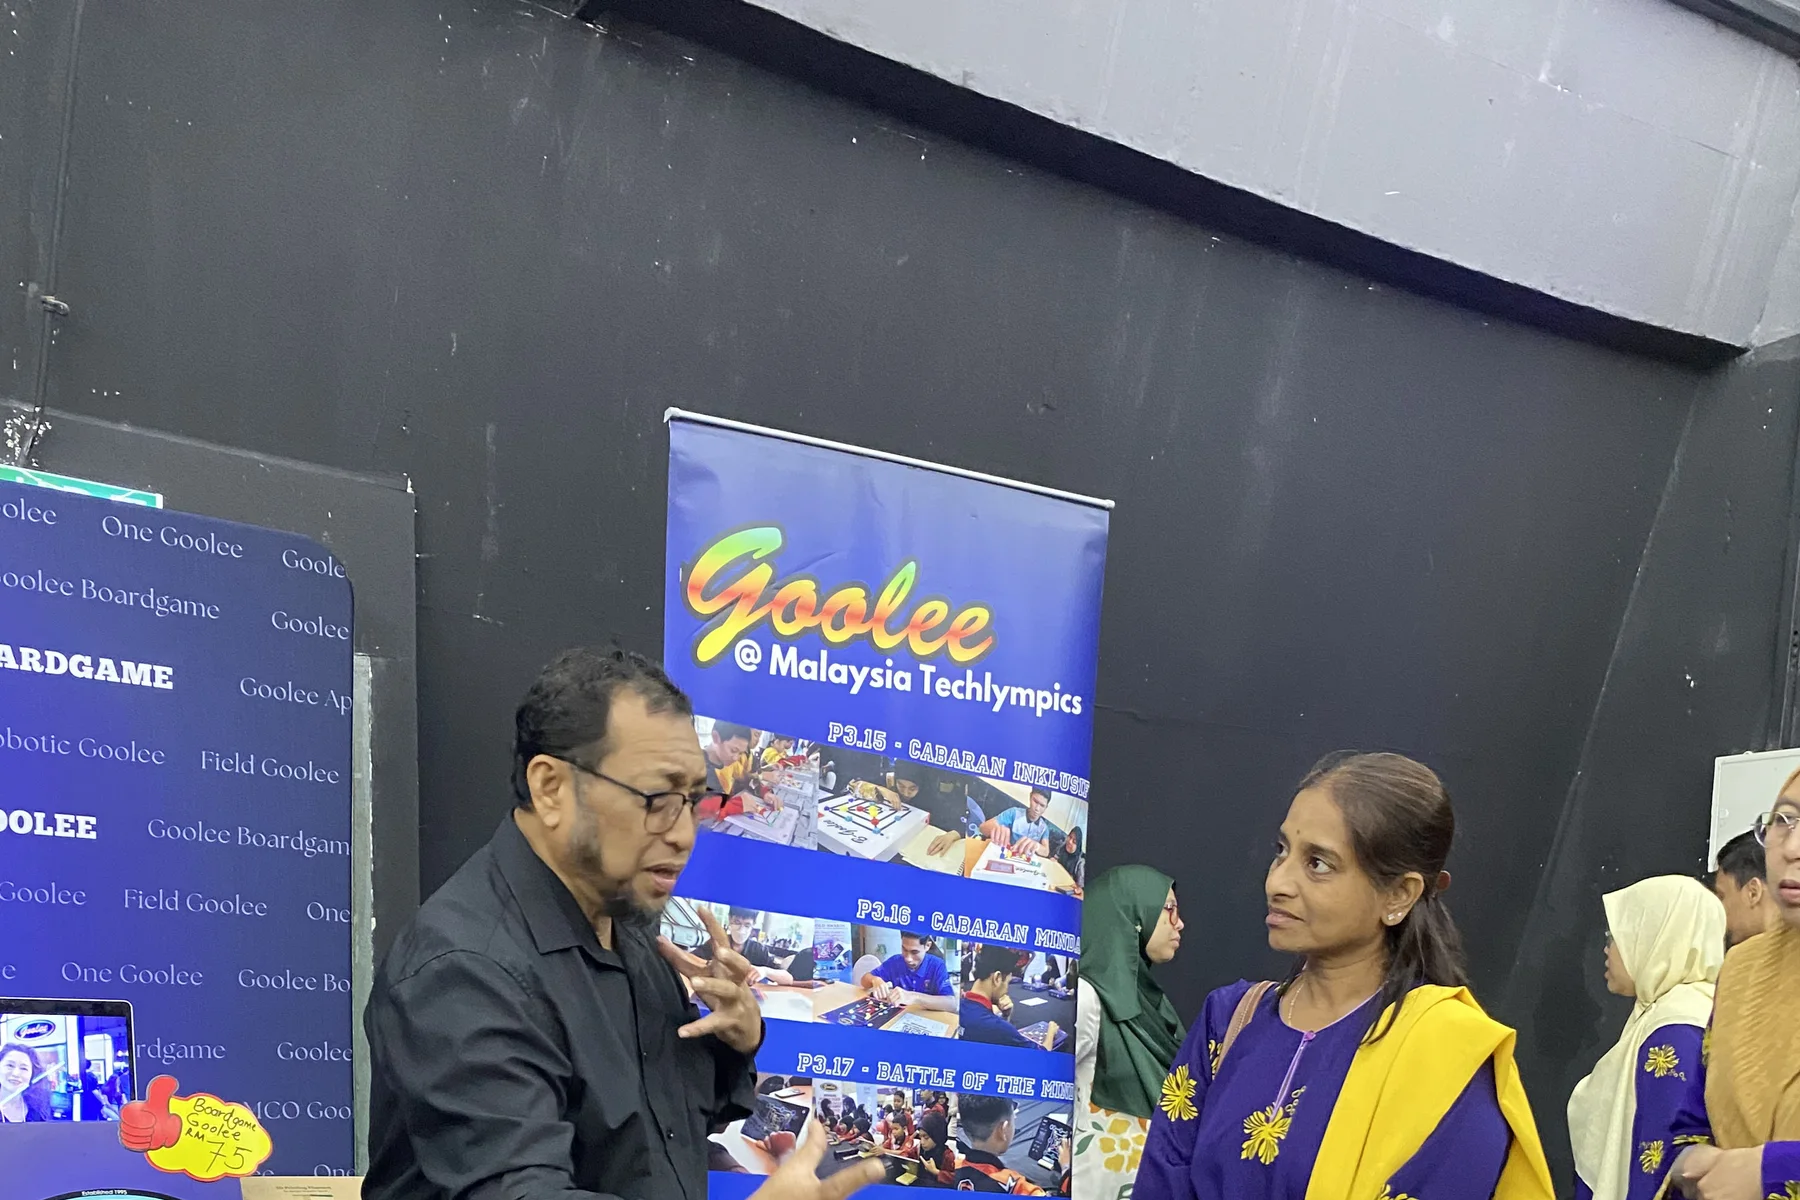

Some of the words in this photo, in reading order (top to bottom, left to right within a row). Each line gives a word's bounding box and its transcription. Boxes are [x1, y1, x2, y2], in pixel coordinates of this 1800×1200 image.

[0, 498, 57, 525] olee
[102, 515, 153, 542] One
[160, 526, 243, 558] Goolee
[282, 549, 348, 578] Goole
[0, 569, 73, 596] oolee
[82, 578, 219, 620] Boardgame
[686, 526, 993, 663] Goolee
[271, 611, 349, 640] Goolee
[240, 677, 319, 705] Goolee
[734, 639, 762, 672] @
[769, 644, 912, 695] Malaysia
[919, 665, 1082, 717] Techlympics
[78, 737, 166, 765] Goolee
[828, 722, 887, 751] P3.15
[908, 739, 1006, 778] CABARAN
[200, 750, 255, 775] Field
[261, 758, 340, 784] Goolee
[148, 819, 231, 845] Goolee
[238, 826, 351, 858] Boardgam
[0, 881, 87, 905] Goolee
[124, 888, 179, 911] Field
[186, 892, 267, 917] Goolee
[856, 898, 911, 926] P3.16
[930, 911, 1029, 944] CABARAN
[61, 962, 112, 983] One
[119, 964, 203, 986] Goolee
[238, 969, 317, 991] Goolee
[796, 1052, 855, 1078] P3.17
[876, 1061, 956, 1088] BATTLE
[961, 1070, 990, 1092] OF
[995, 1073, 1036, 1097] THE
[193, 1098, 257, 1131] Boardgame
[306, 1101, 353, 1120] Goo
[187, 1112, 242, 1141] Goolee
[185, 1128, 205, 1142] RM
[206, 1140, 253, 1173] 75
